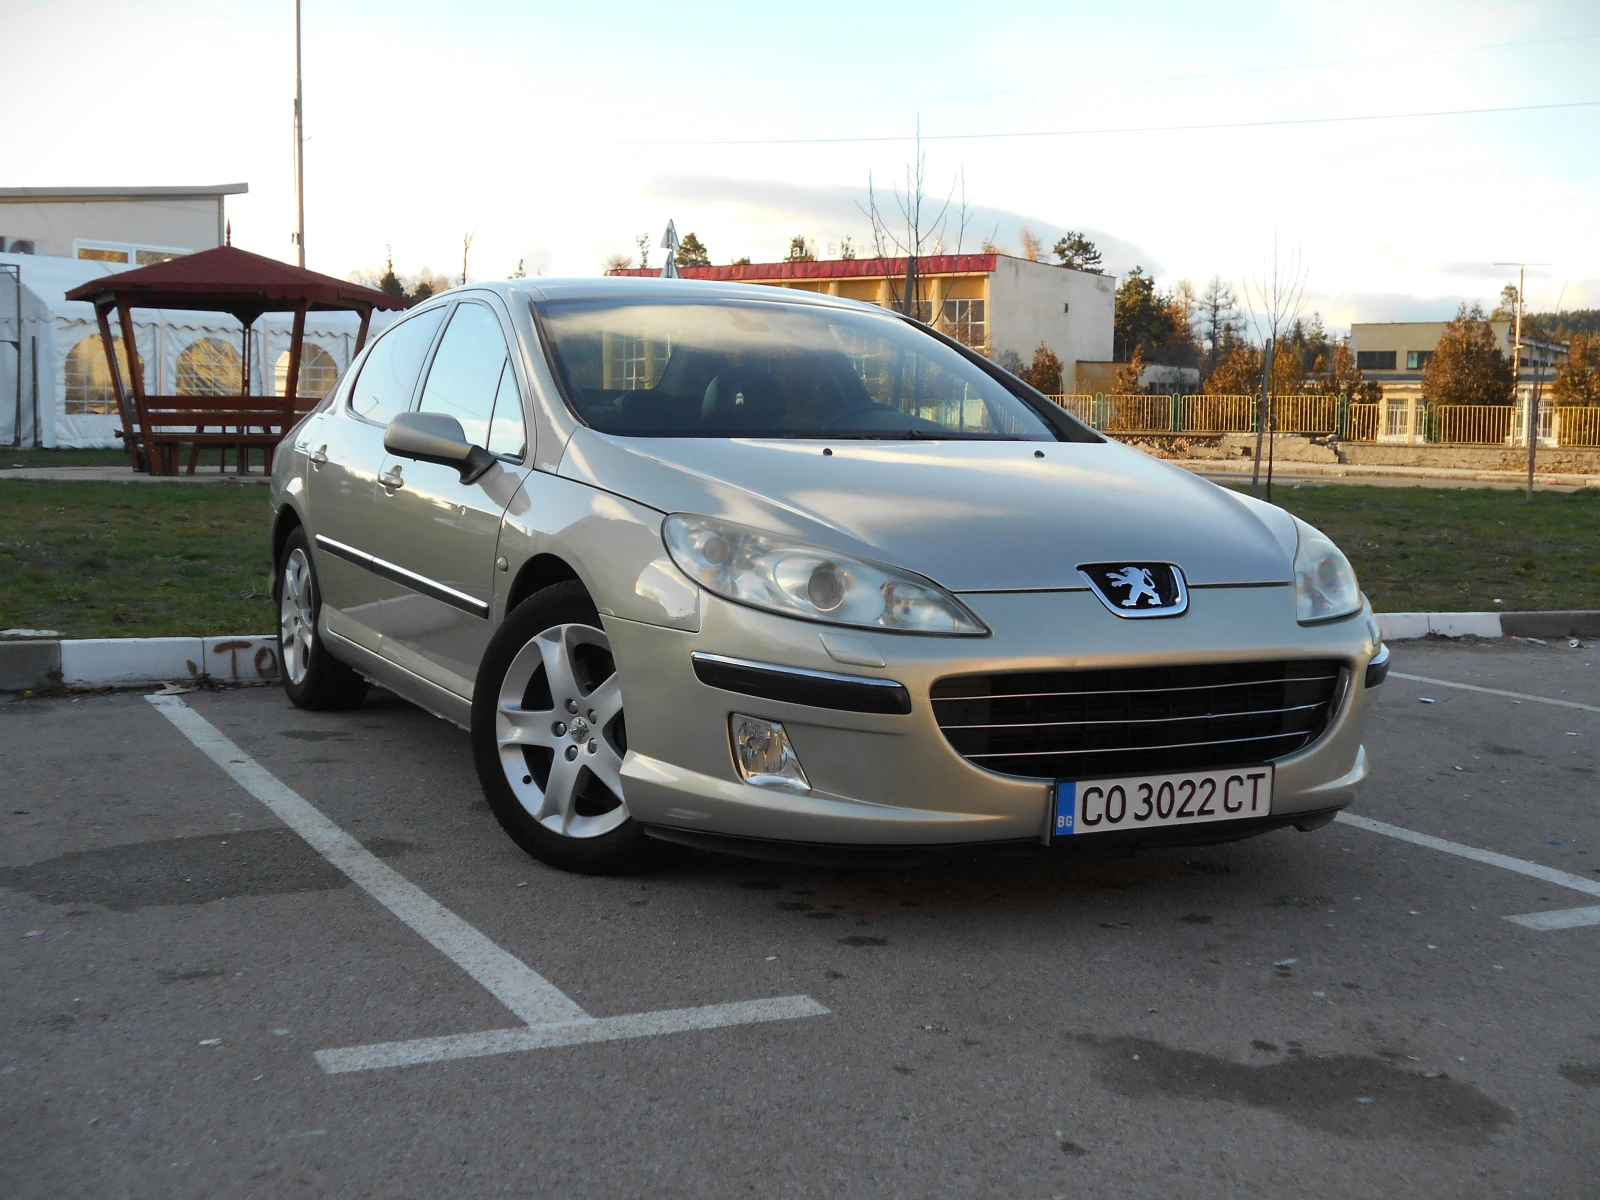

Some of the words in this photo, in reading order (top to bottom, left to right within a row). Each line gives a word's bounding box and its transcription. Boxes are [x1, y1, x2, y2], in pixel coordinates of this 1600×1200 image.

[1081, 784, 1127, 826] CO
[1134, 777, 1217, 822] 3022
[1223, 772, 1266, 813] CT
[1057, 814, 1073, 828] BG
